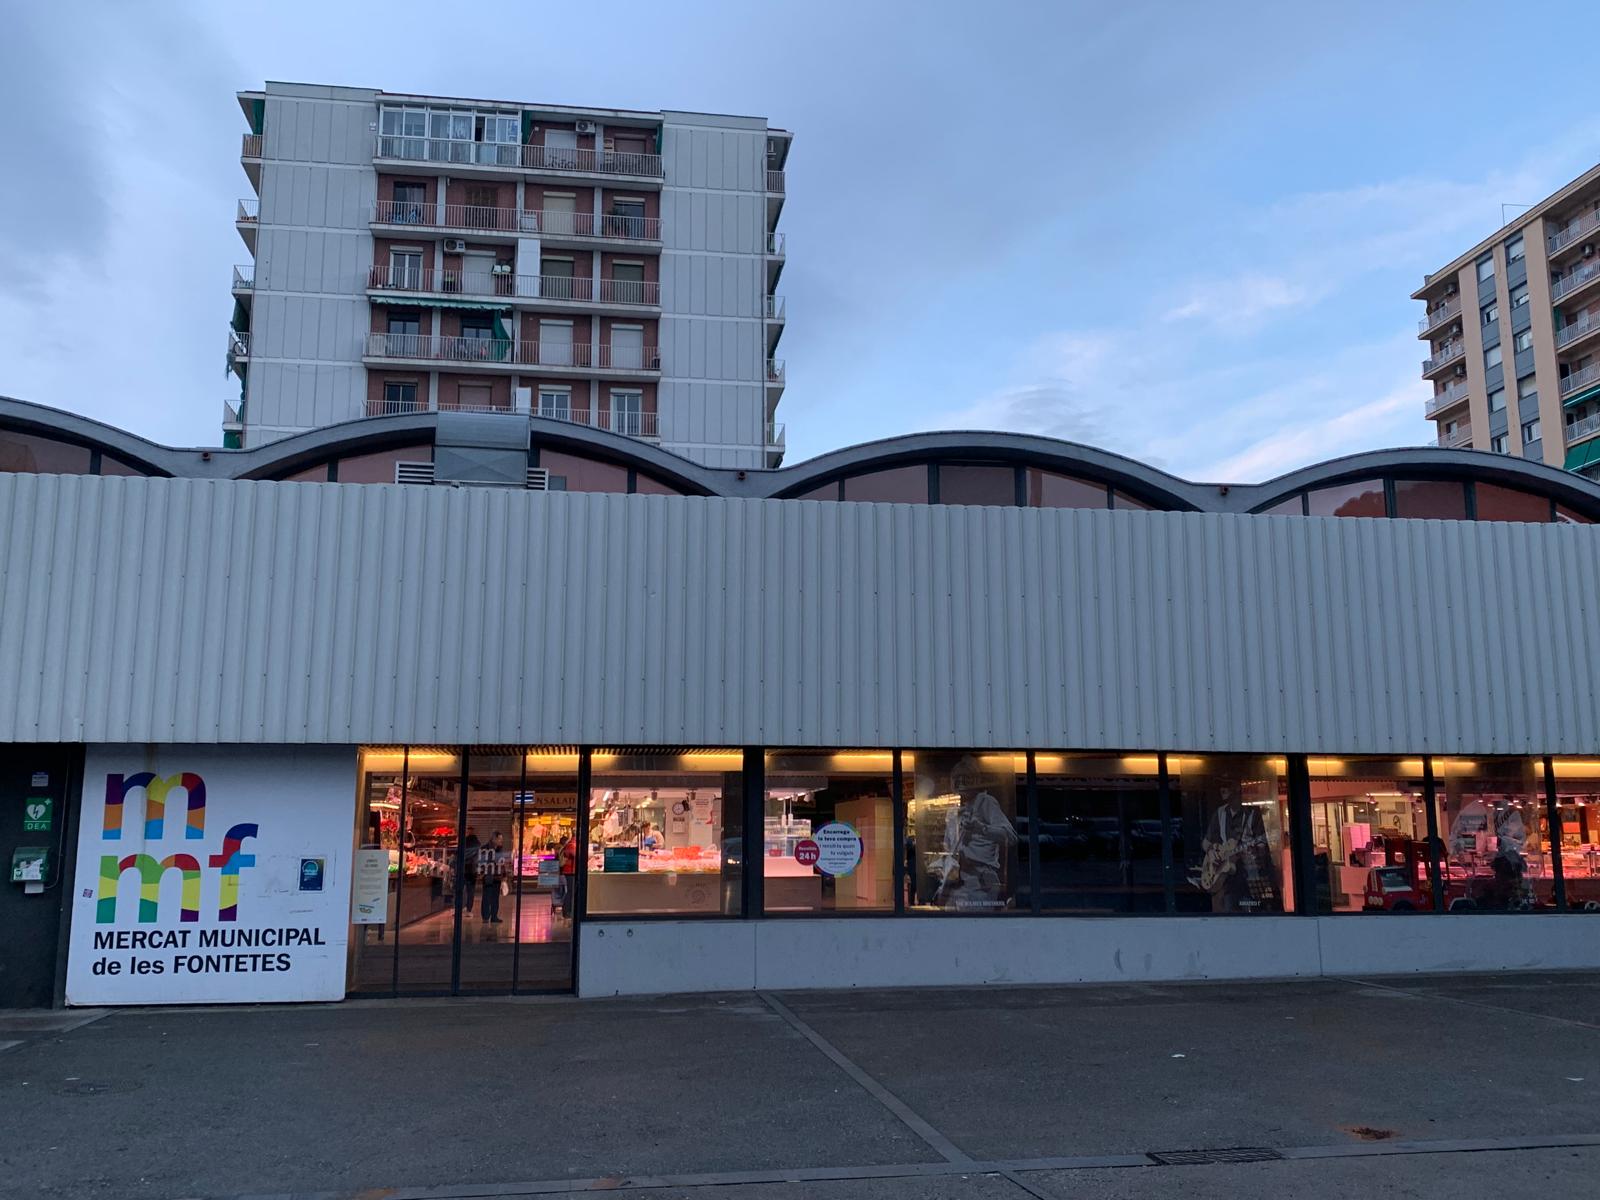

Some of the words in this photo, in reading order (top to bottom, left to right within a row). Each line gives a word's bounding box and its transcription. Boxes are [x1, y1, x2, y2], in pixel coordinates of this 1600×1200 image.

[103, 772, 206, 840] m
[94, 930, 191, 950] MERCAT
[199, 927, 326, 948] MUNICIPAL
[92, 957, 121, 976] de
[130, 956, 165, 975] les
[173, 953, 292, 974] FONTETES
